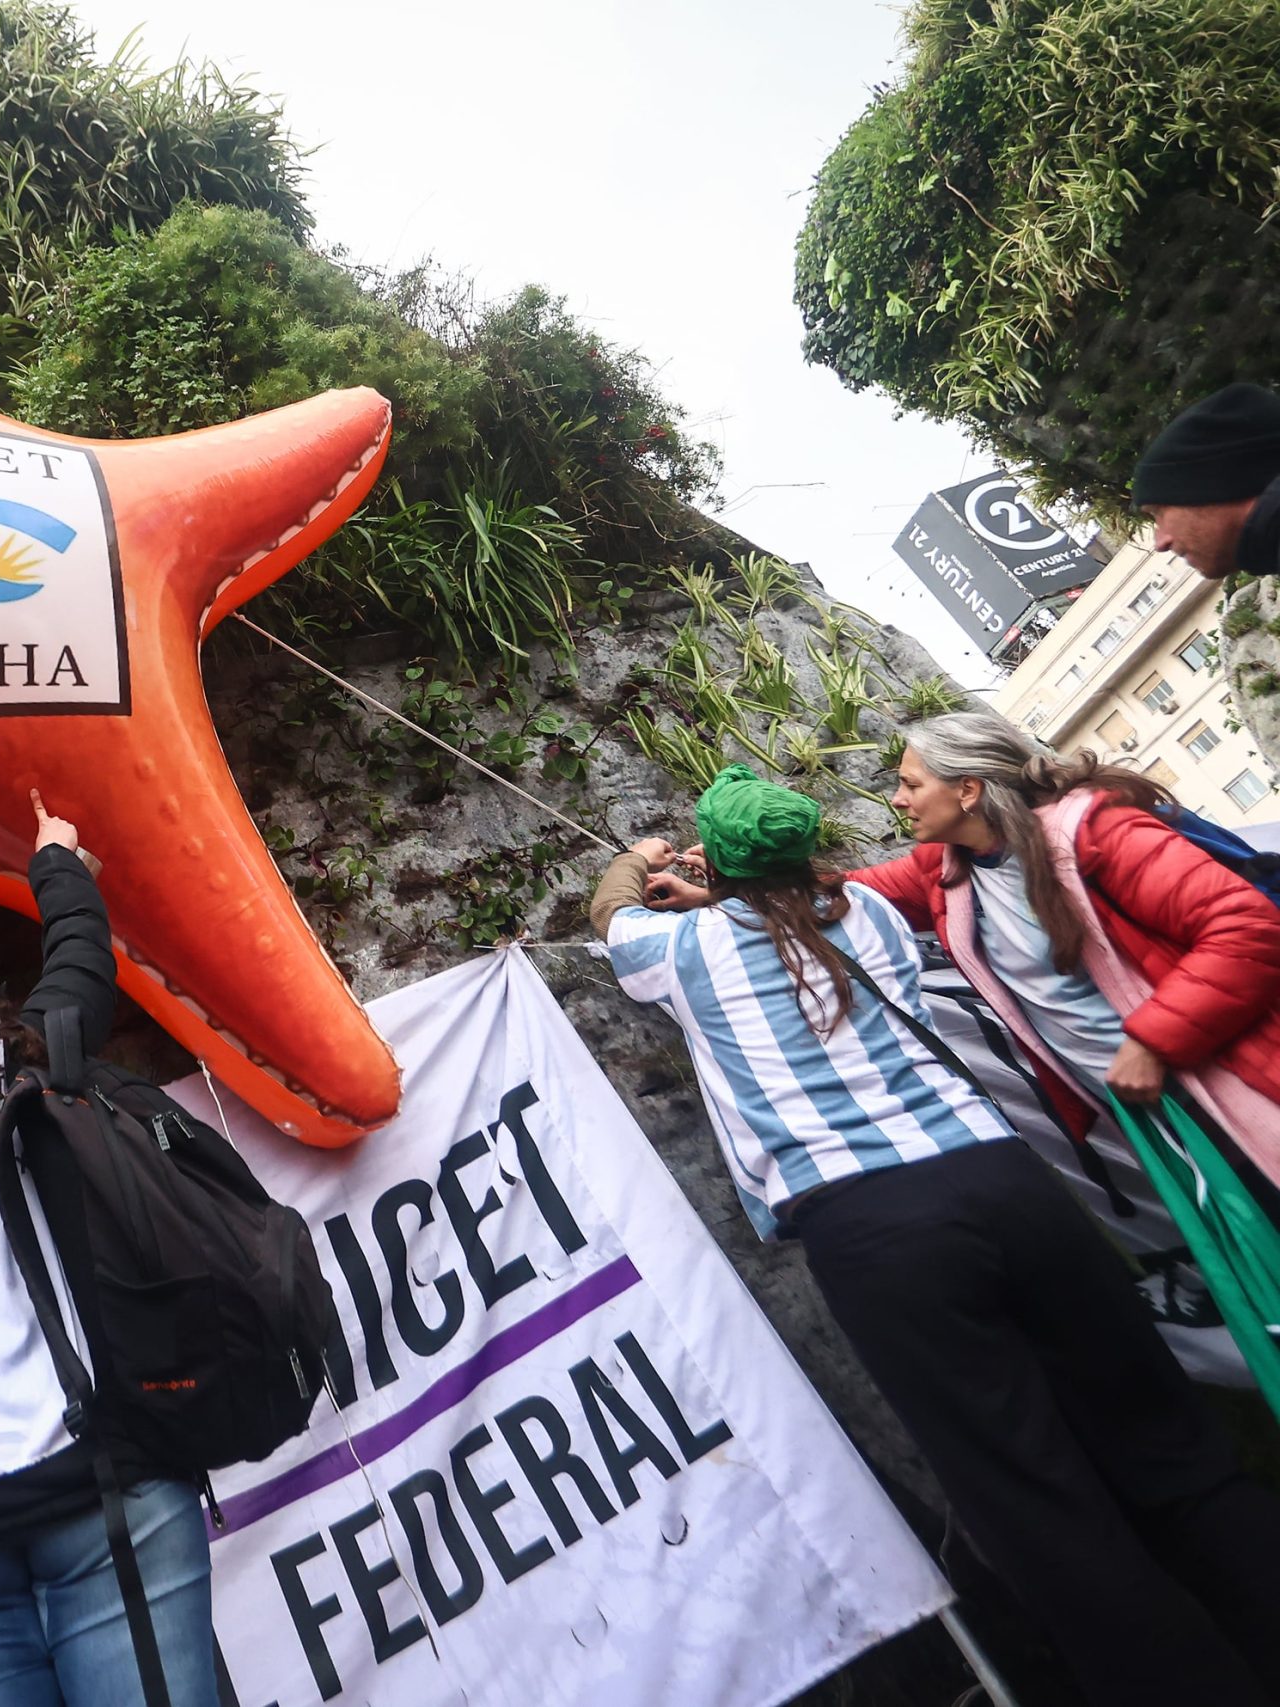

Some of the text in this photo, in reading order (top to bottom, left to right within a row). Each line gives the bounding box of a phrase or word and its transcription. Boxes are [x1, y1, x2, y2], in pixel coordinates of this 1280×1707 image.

[907, 522, 1004, 633] CENTURY 21
[1013, 547, 1087, 576] CENTURY 21
[269, 1330, 734, 1702] FEDERAL
